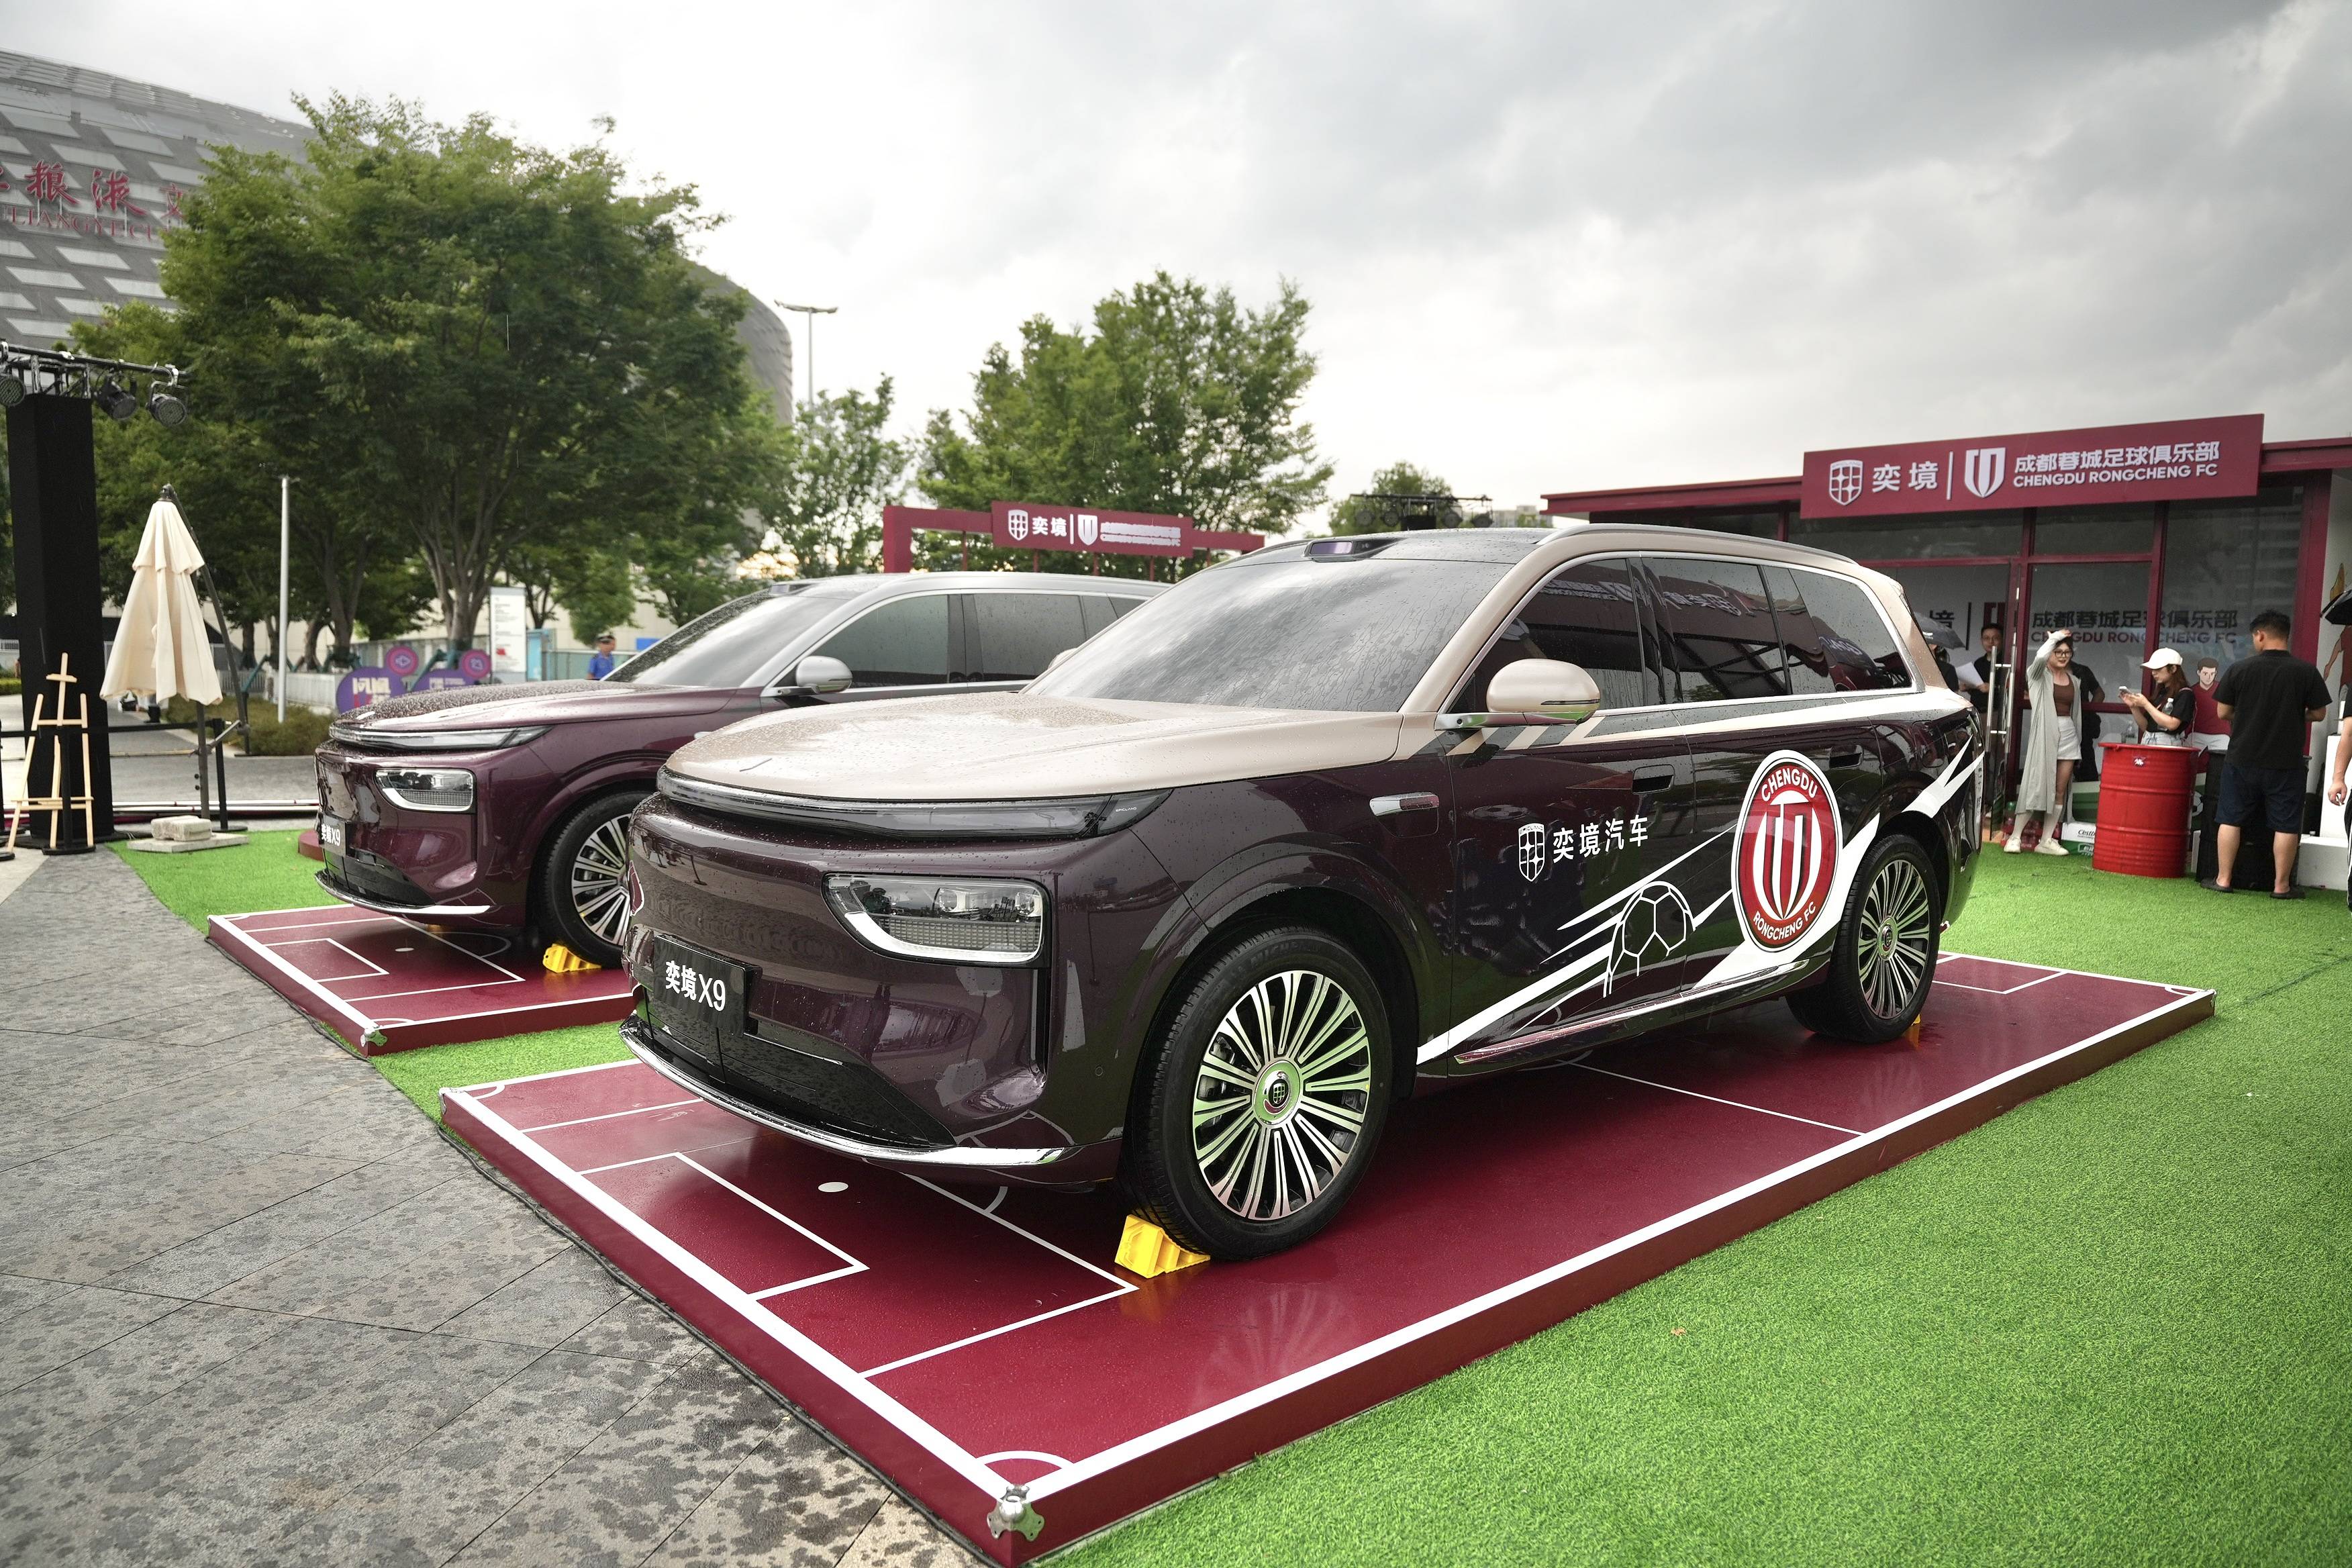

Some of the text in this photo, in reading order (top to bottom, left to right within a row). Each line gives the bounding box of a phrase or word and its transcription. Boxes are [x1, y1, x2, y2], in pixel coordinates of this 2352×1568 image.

[2015, 441, 2220, 473] 成都蓉城足球俱乐部
[1872, 461, 1939, 493] 奕境
[2013, 463, 2218, 488] CHENGDU RONGCHENG FC
[1032, 516, 1067, 537] 奕境
[2031, 632, 2102, 643] CGDU
[1761, 768, 1818, 801] CHENGDU
[1553, 814, 1649, 863] 奕境汽车
[1753, 901, 1816, 940] RONGCHENG FC
[665, 961, 726, 1012] 奕境X9
